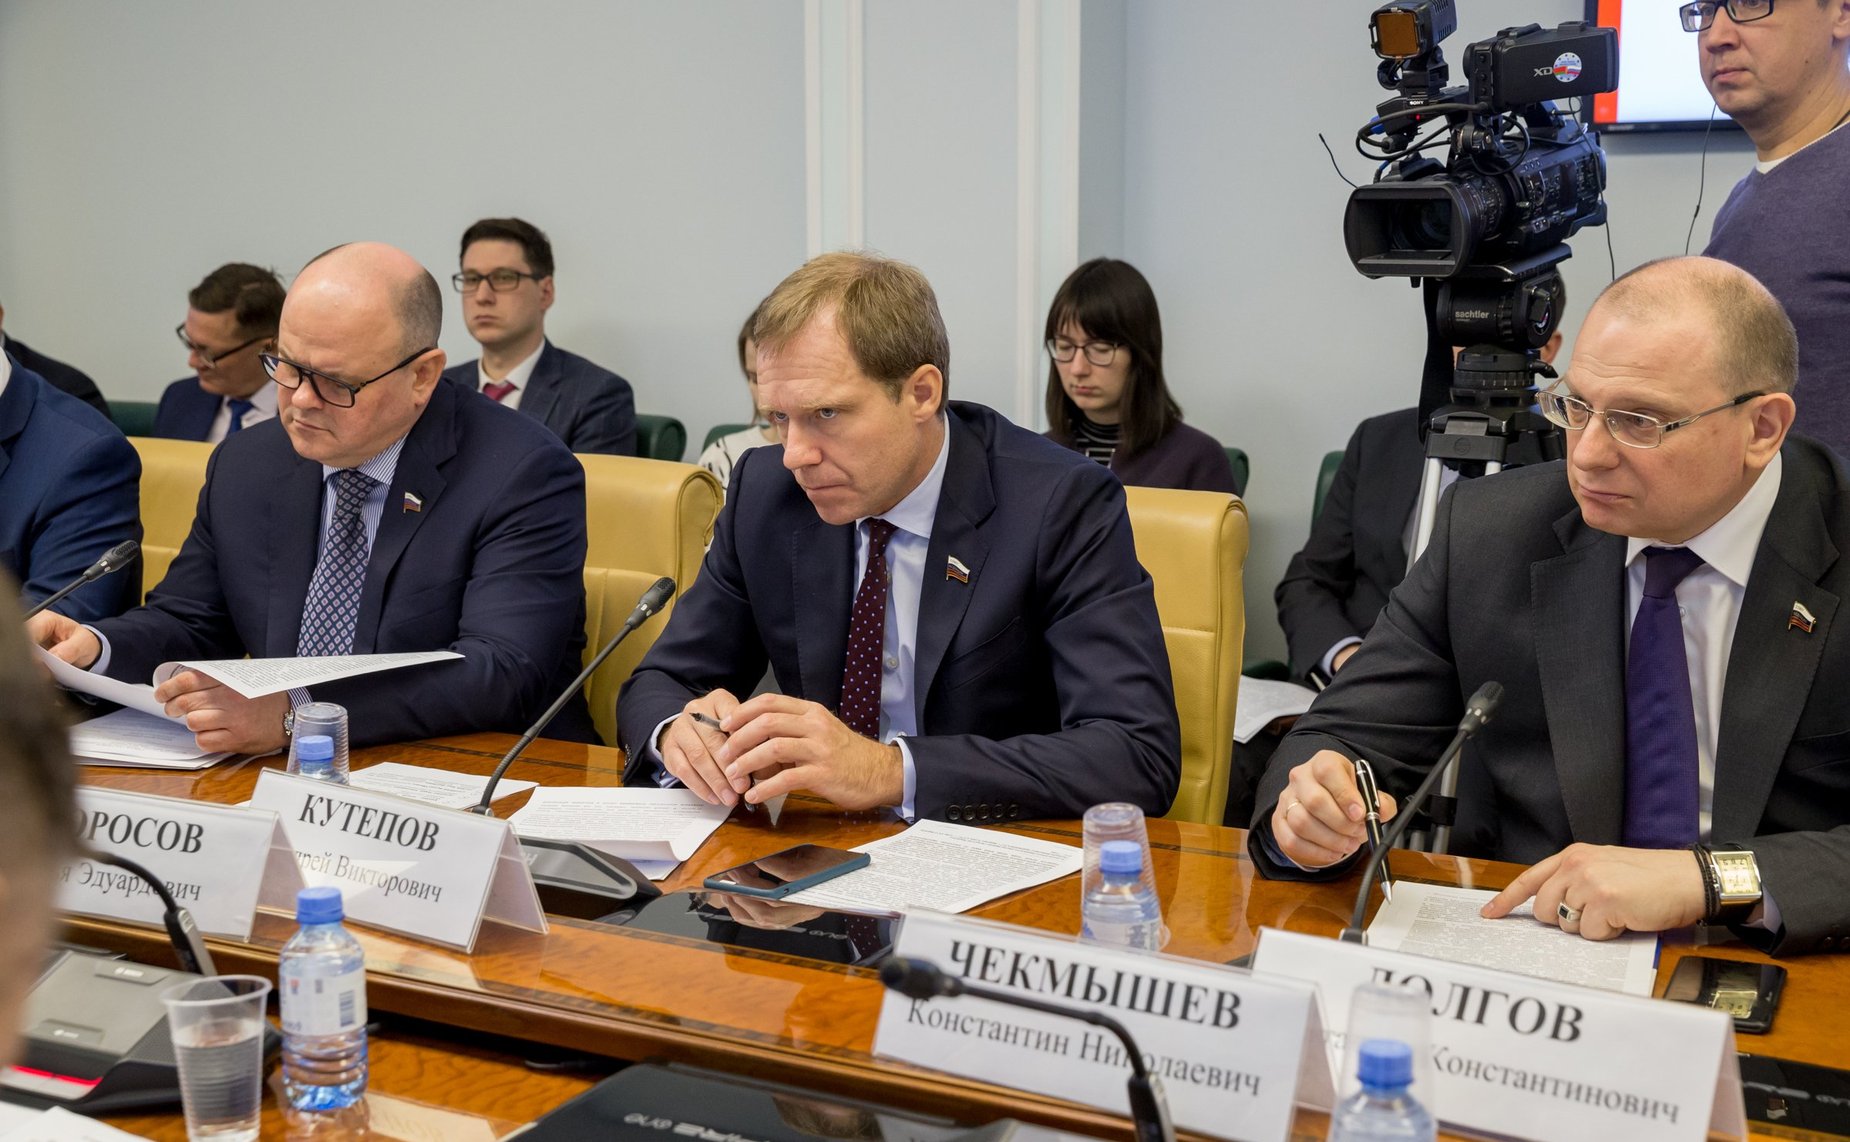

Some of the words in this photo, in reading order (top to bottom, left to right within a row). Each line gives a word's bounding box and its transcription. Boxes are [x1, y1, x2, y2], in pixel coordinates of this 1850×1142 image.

[1455, 310, 1490, 319] sachtler
[298, 793, 440, 851] КУТЕПОВ
[334, 855, 443, 903] Викторович
[949, 939, 1242, 1030] ЧЕКМЫШЕВ
[907, 998, 1070, 1057] Константин
